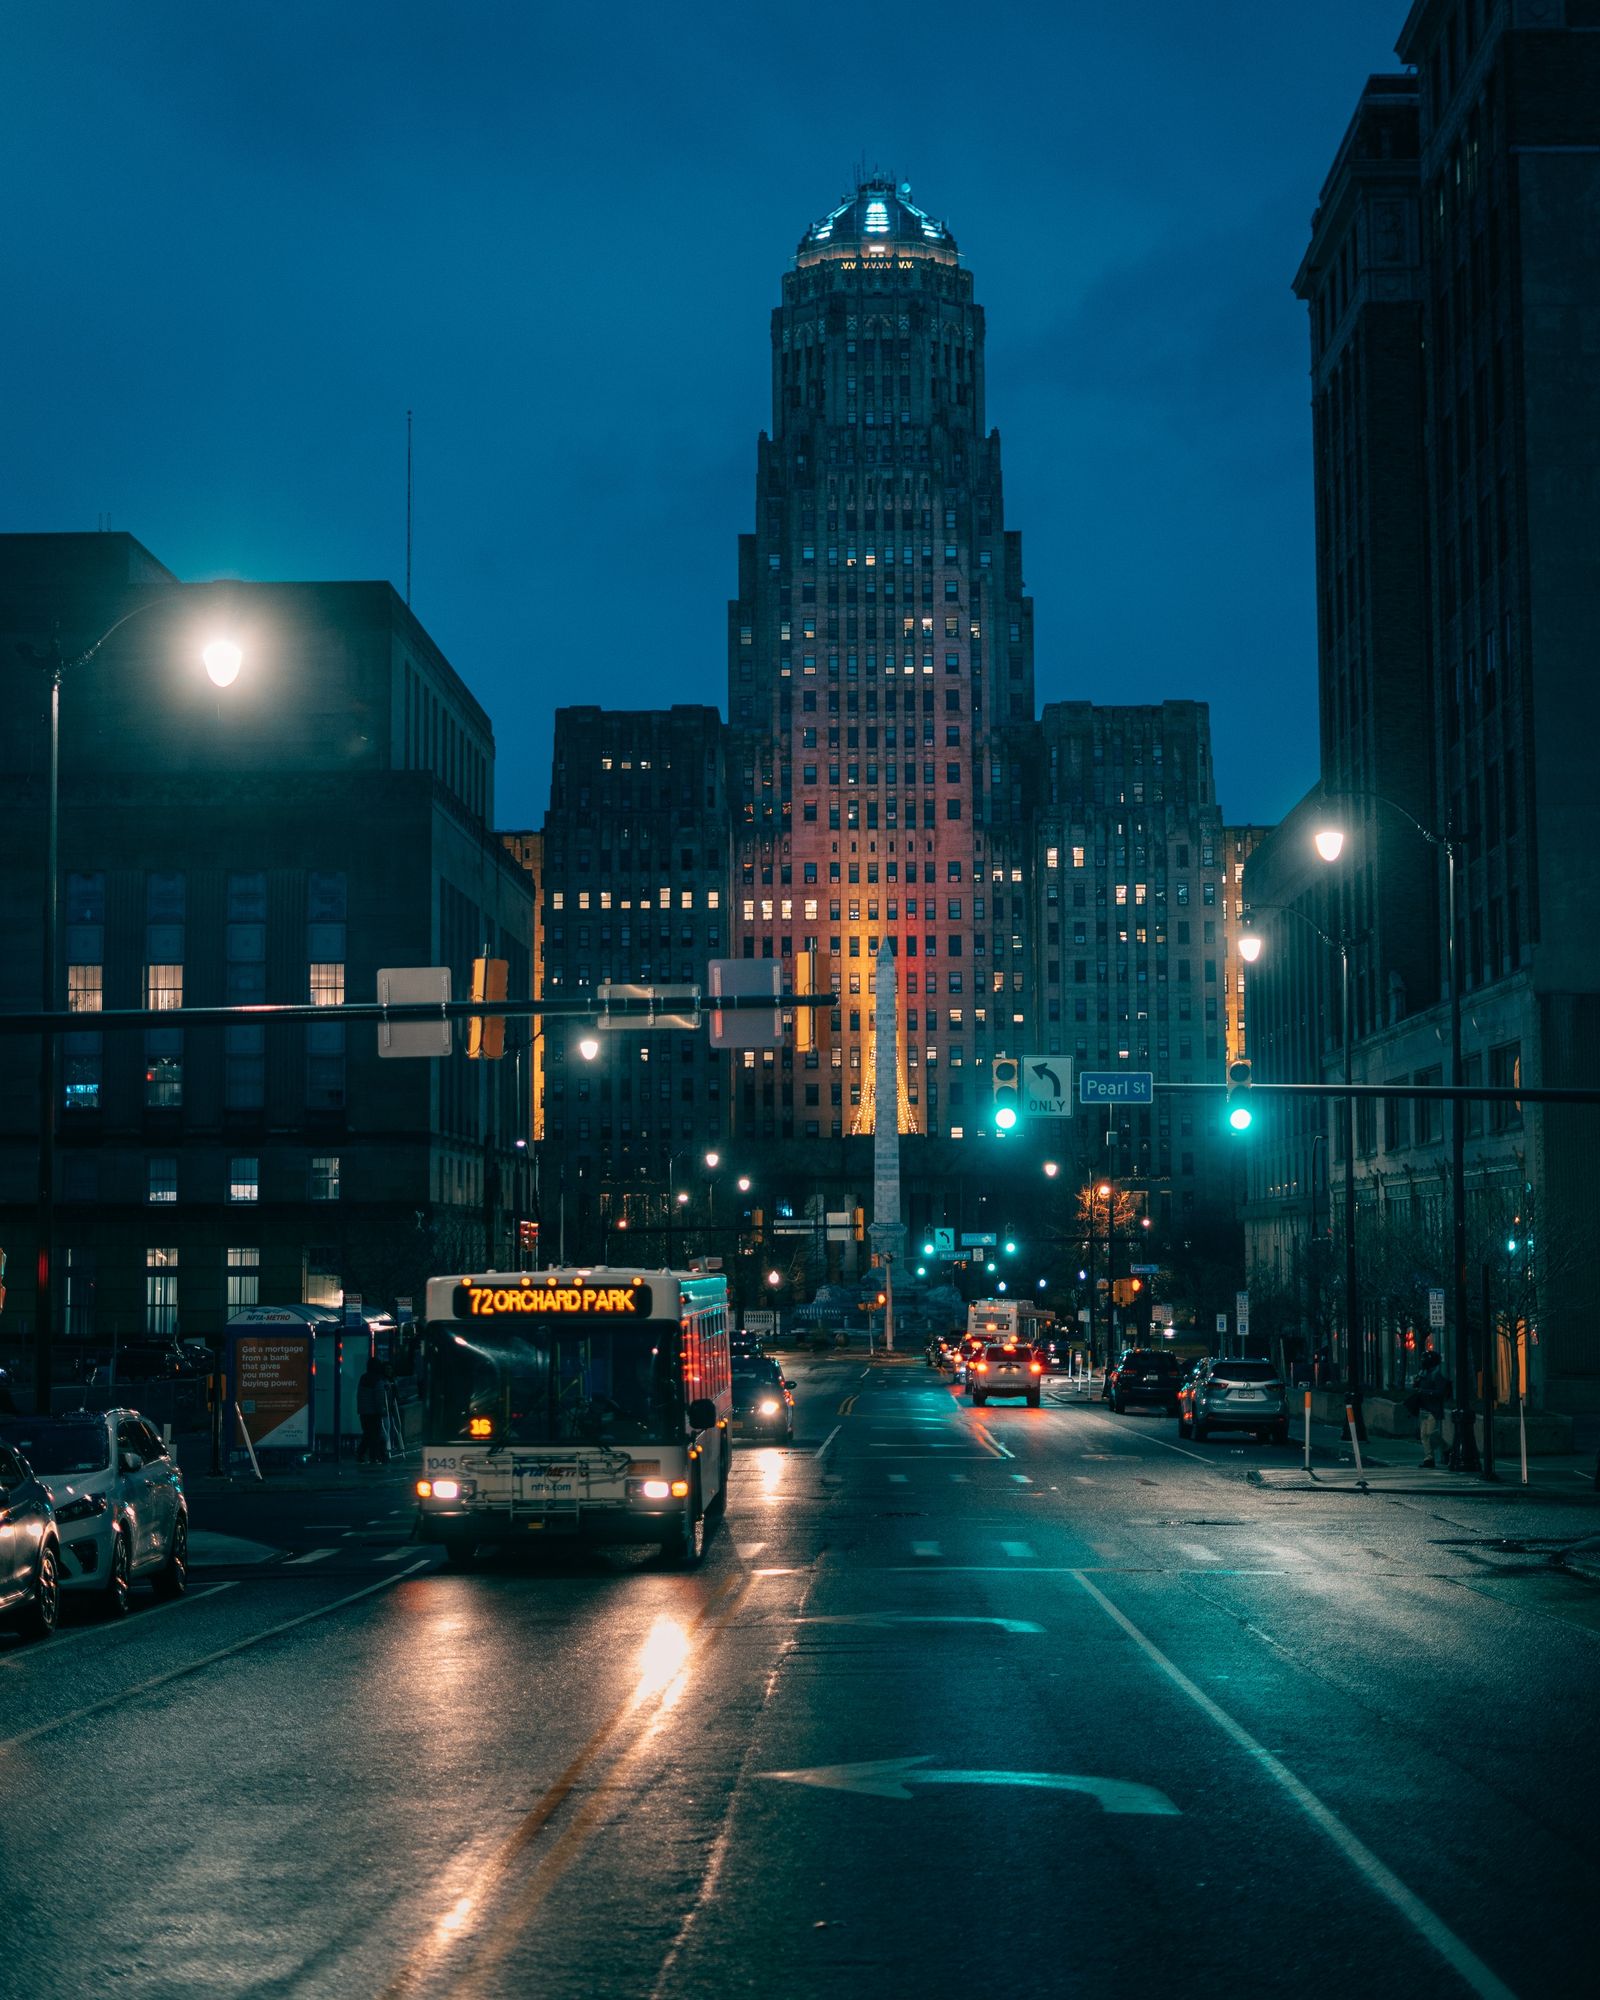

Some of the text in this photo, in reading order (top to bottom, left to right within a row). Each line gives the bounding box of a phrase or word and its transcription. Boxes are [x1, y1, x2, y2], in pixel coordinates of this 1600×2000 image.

[1087, 1080, 1146, 1095] Pearl St
[1029, 1100, 1065, 1112] ONLY
[469, 1288, 636, 1315] 72 ORCHARD PARK
[265, 1346, 304, 1354] mortgage
[260, 1363, 280, 1371] gives
[242, 1380, 269, 1388] buying
[428, 1457, 457, 1470] 1043
